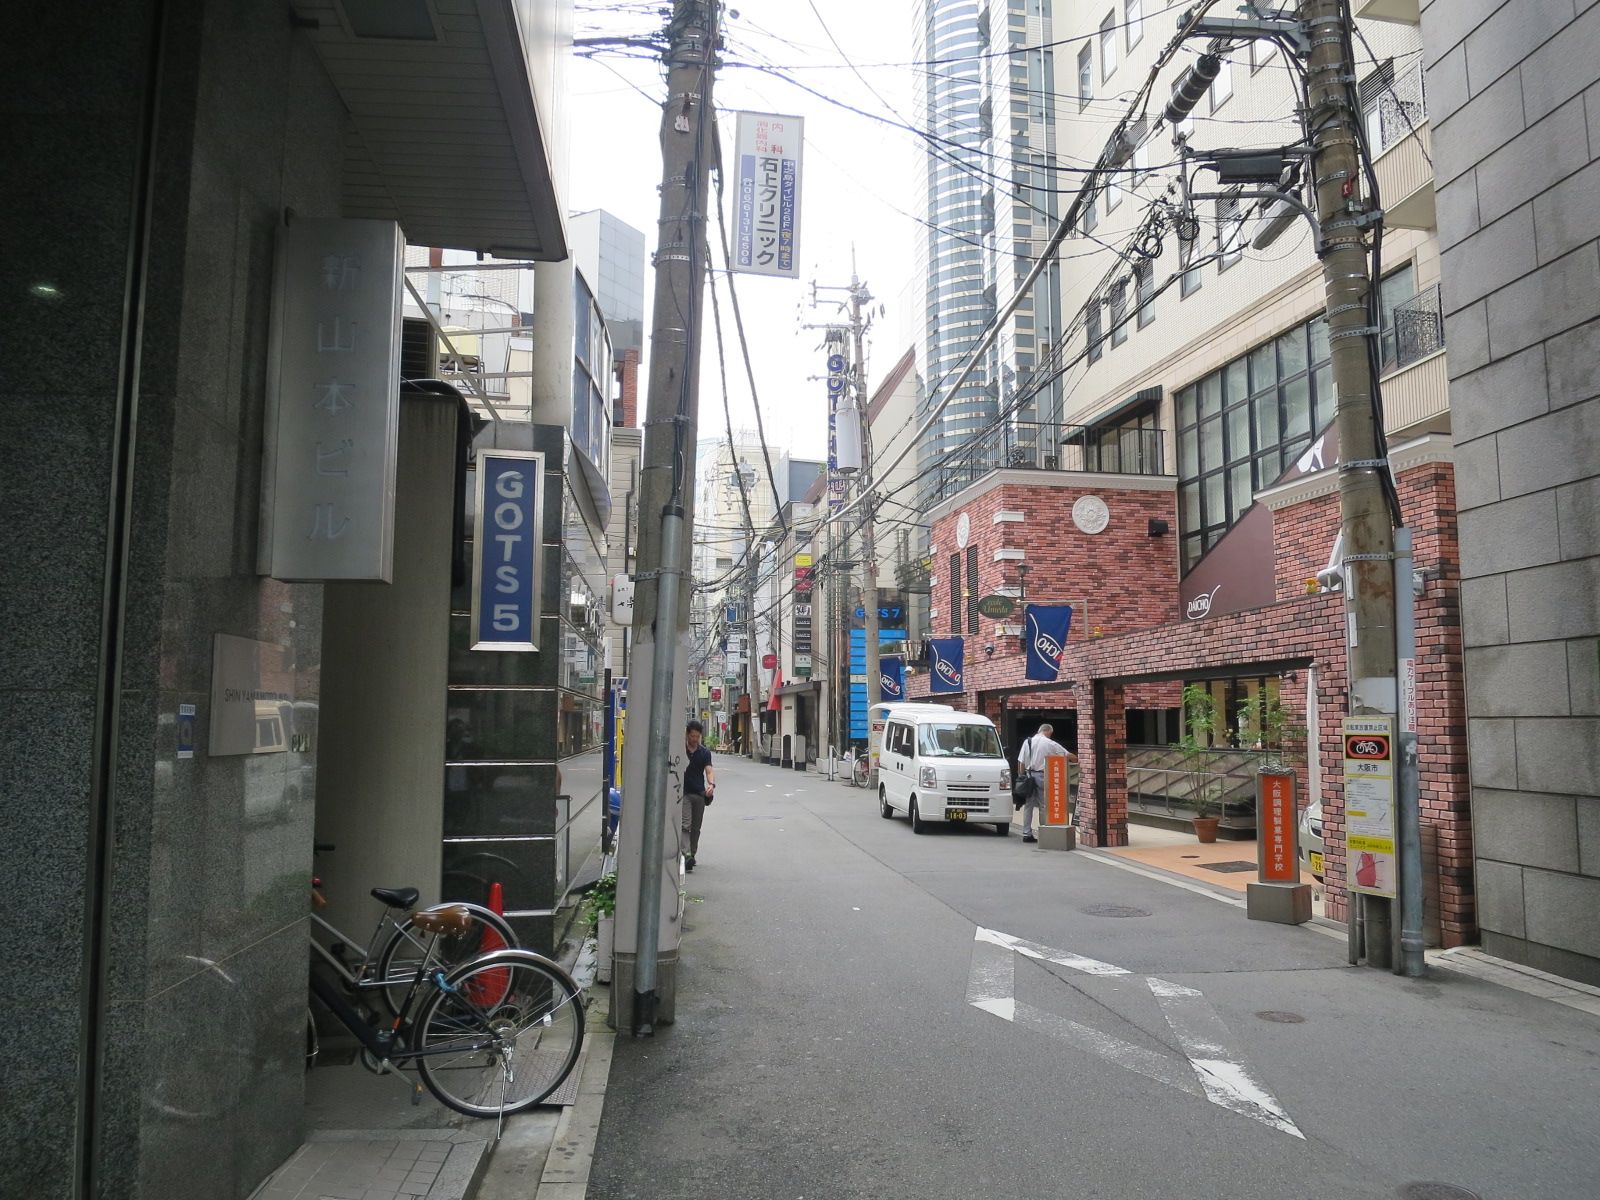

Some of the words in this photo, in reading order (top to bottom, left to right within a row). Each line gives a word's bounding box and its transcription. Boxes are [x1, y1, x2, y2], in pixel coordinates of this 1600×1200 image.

[756, 156, 778, 266] 石上クリニック
[307, 254, 361, 541] 新山本ビル
[494, 470, 525, 594] GOTS
[492, 603, 520, 632] 5
[855, 607, 889, 618] GS
[1357, 763, 1379, 772] 大阪市
